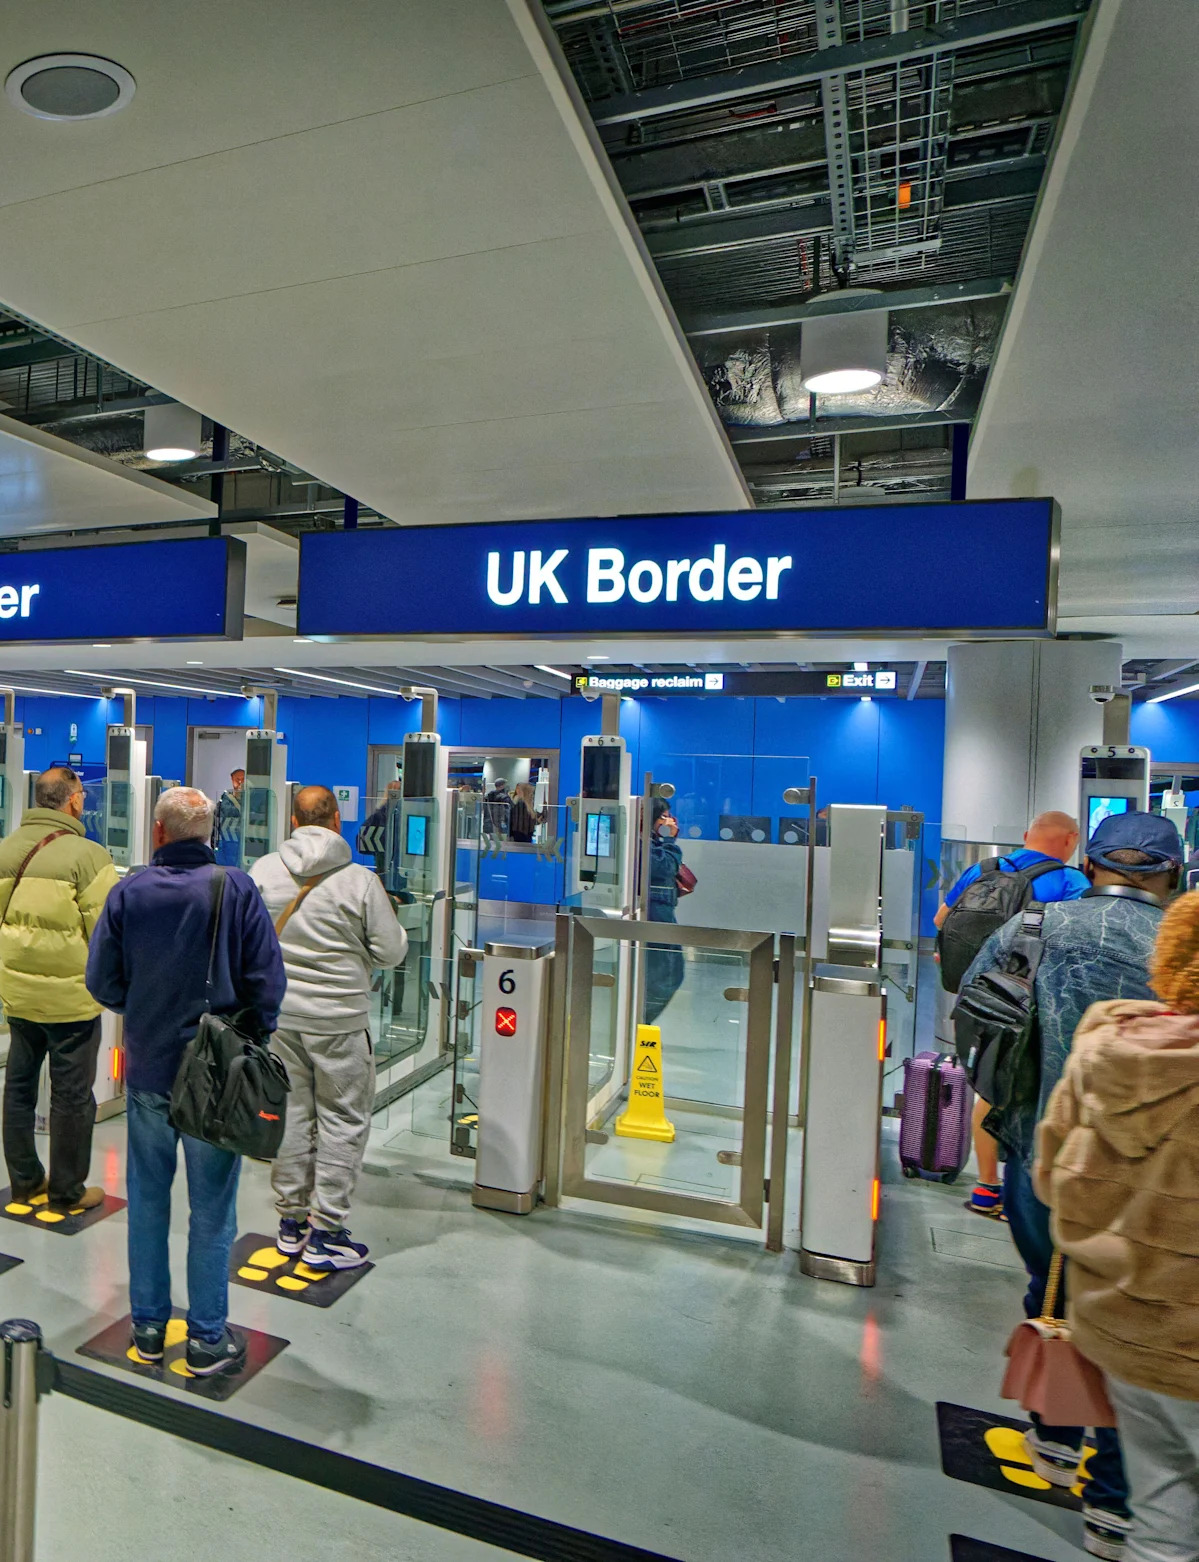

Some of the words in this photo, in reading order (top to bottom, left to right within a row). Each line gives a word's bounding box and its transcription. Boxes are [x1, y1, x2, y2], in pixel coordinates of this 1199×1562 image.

[486, 549, 569, 606] UK
[586, 543, 793, 604] Border
[589, 676, 649, 690] Baggage
[651, 676, 703, 688] reclaim
[843, 674, 874, 687] Exit
[416, 733, 423, 743] 7
[597, 736, 604, 746] 6
[1107, 746, 1116, 758] 5
[498, 969, 516, 995] 6
[634, 1089, 660, 1098] FLOOR
